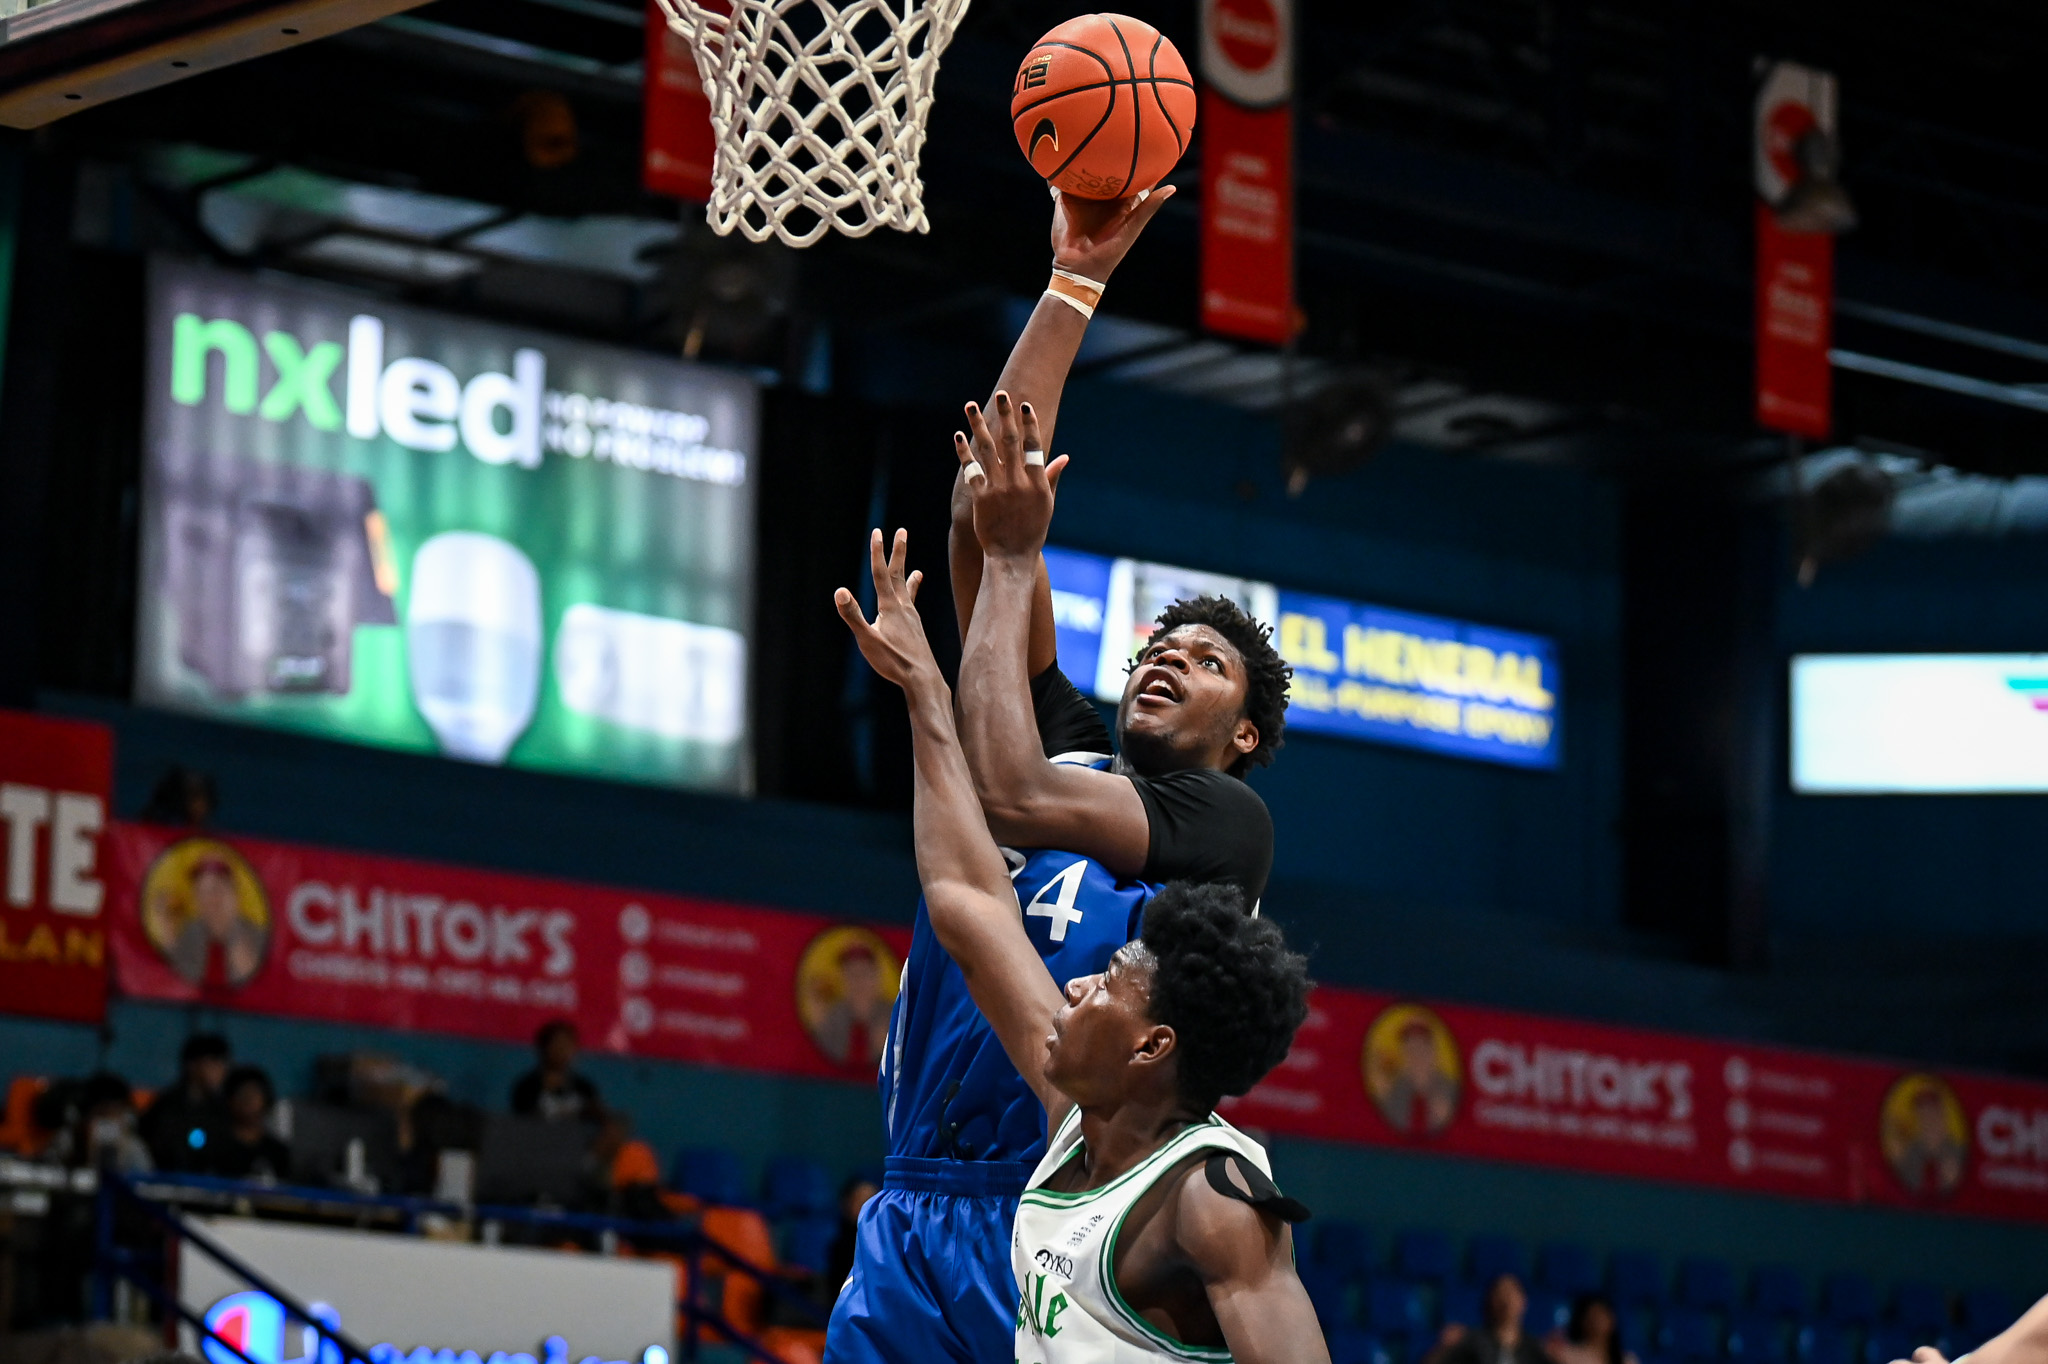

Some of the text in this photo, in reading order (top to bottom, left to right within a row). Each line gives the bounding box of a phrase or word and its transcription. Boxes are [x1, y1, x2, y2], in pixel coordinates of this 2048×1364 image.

[171, 313, 547, 468] nxled
[1280, 613, 1338, 673] EL
[0, 782, 105, 917] TE
